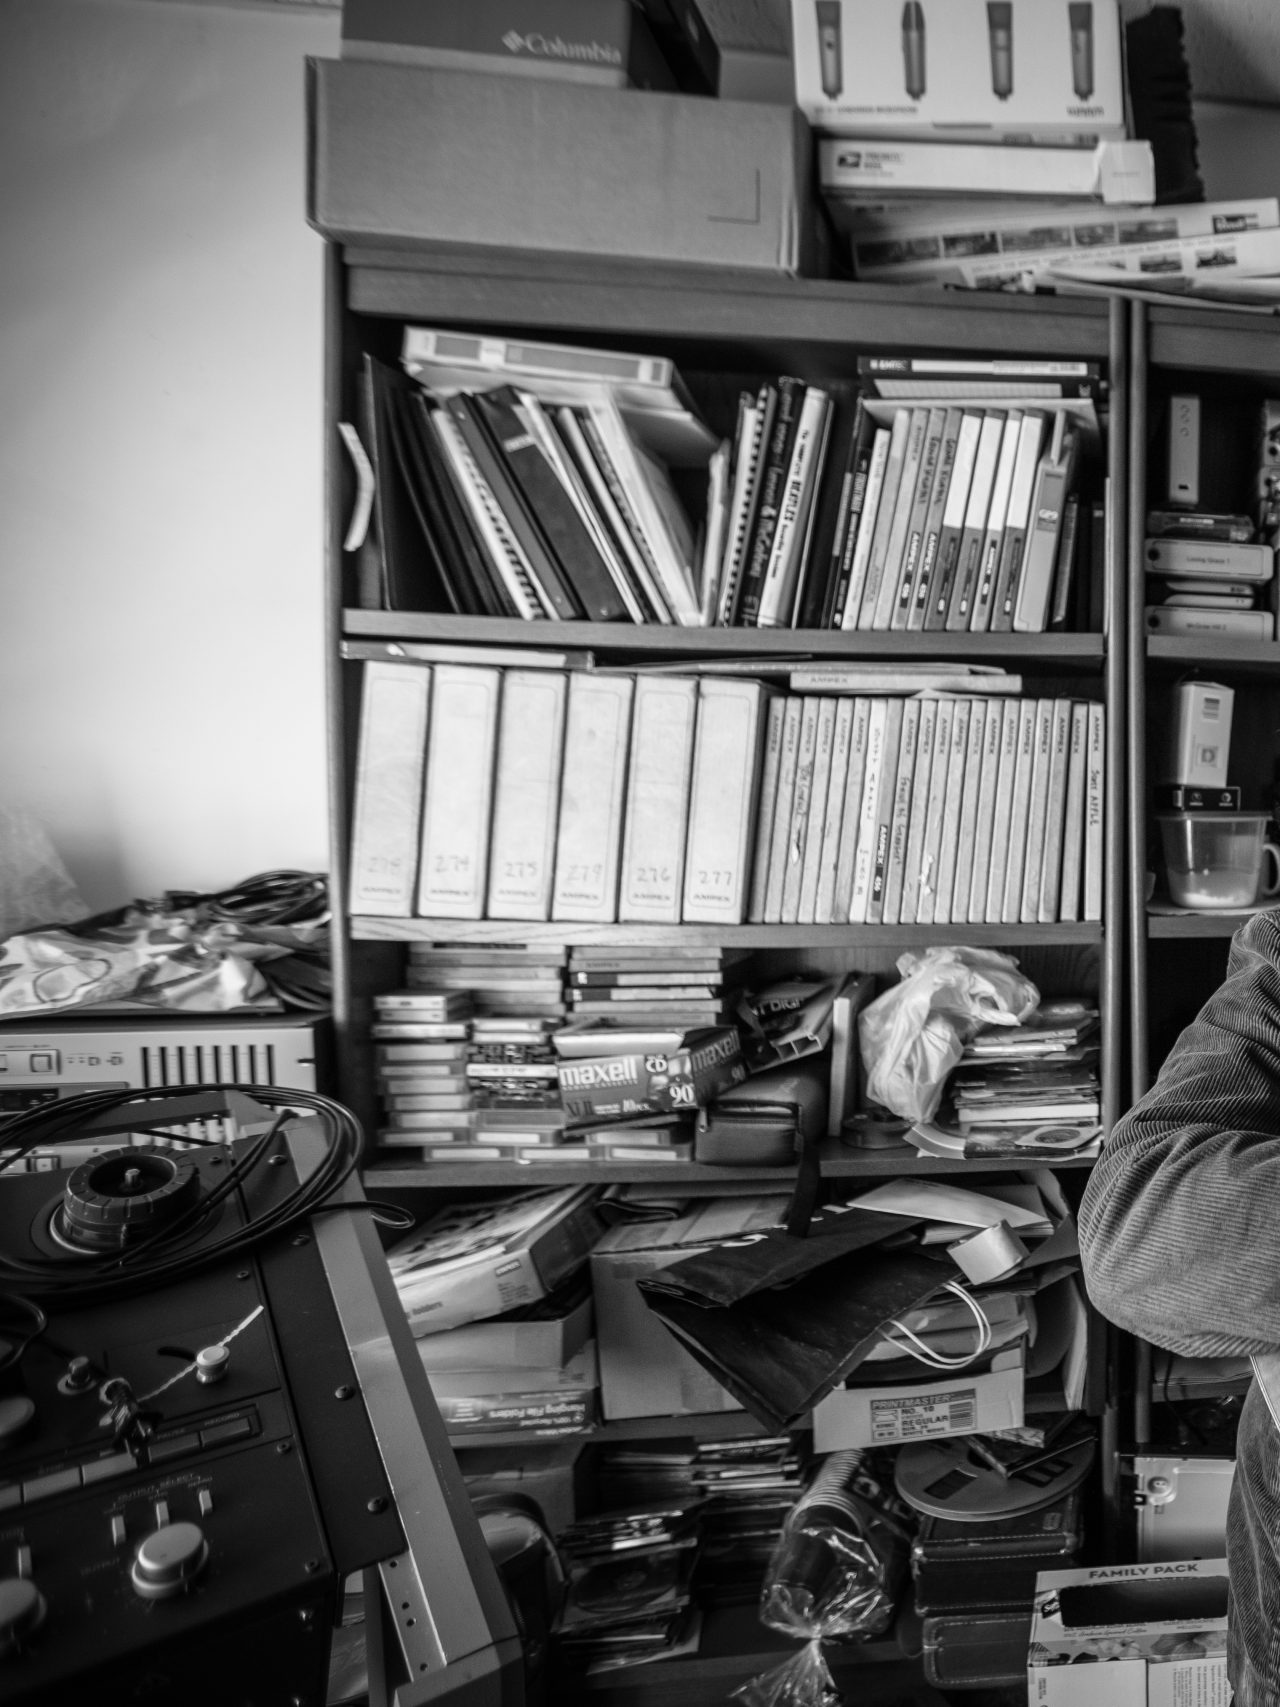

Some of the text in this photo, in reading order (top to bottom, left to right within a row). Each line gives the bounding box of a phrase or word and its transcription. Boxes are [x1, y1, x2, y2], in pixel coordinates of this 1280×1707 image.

[525, 33, 622, 65] Columbia
[783, 481, 803, 522] BEATLES
[907, 532, 920, 571] AMPEX
[924, 532, 937, 572] AMPEX
[905, 718, 914, 755] AMPEX
[923, 717, 932, 755] AMPEX
[939, 717, 948, 755] AMPEX
[955, 718, 965, 754] AMPEX
[973, 718, 982, 755] AMPEX
[988, 717, 998, 754] AMPEX
[1006, 718, 1015, 755] AMPEX
[1023, 718, 1032, 755] AMPEX
[1040, 717, 1050, 754] AMPEX
[1057, 717, 1066, 754] AMPEX
[1073, 718, 1081, 754] AMPEX
[1093, 716, 1101, 752] AMPEX
[876, 825, 888, 865] AMPEX
[637, 866, 672, 883] 276
[698, 869, 734, 886] 277
[560, 1056, 668, 1087] maxell CD
[670, 1084, 695, 1106] 90
[490, 1403, 586, 1419] Hanging File Folders
[873, 1394, 951, 1410] PRINTMASTER
[902, 1415, 949, 1426] REGULAR
[1088, 1563, 1199, 1580] FAMILY PACK
